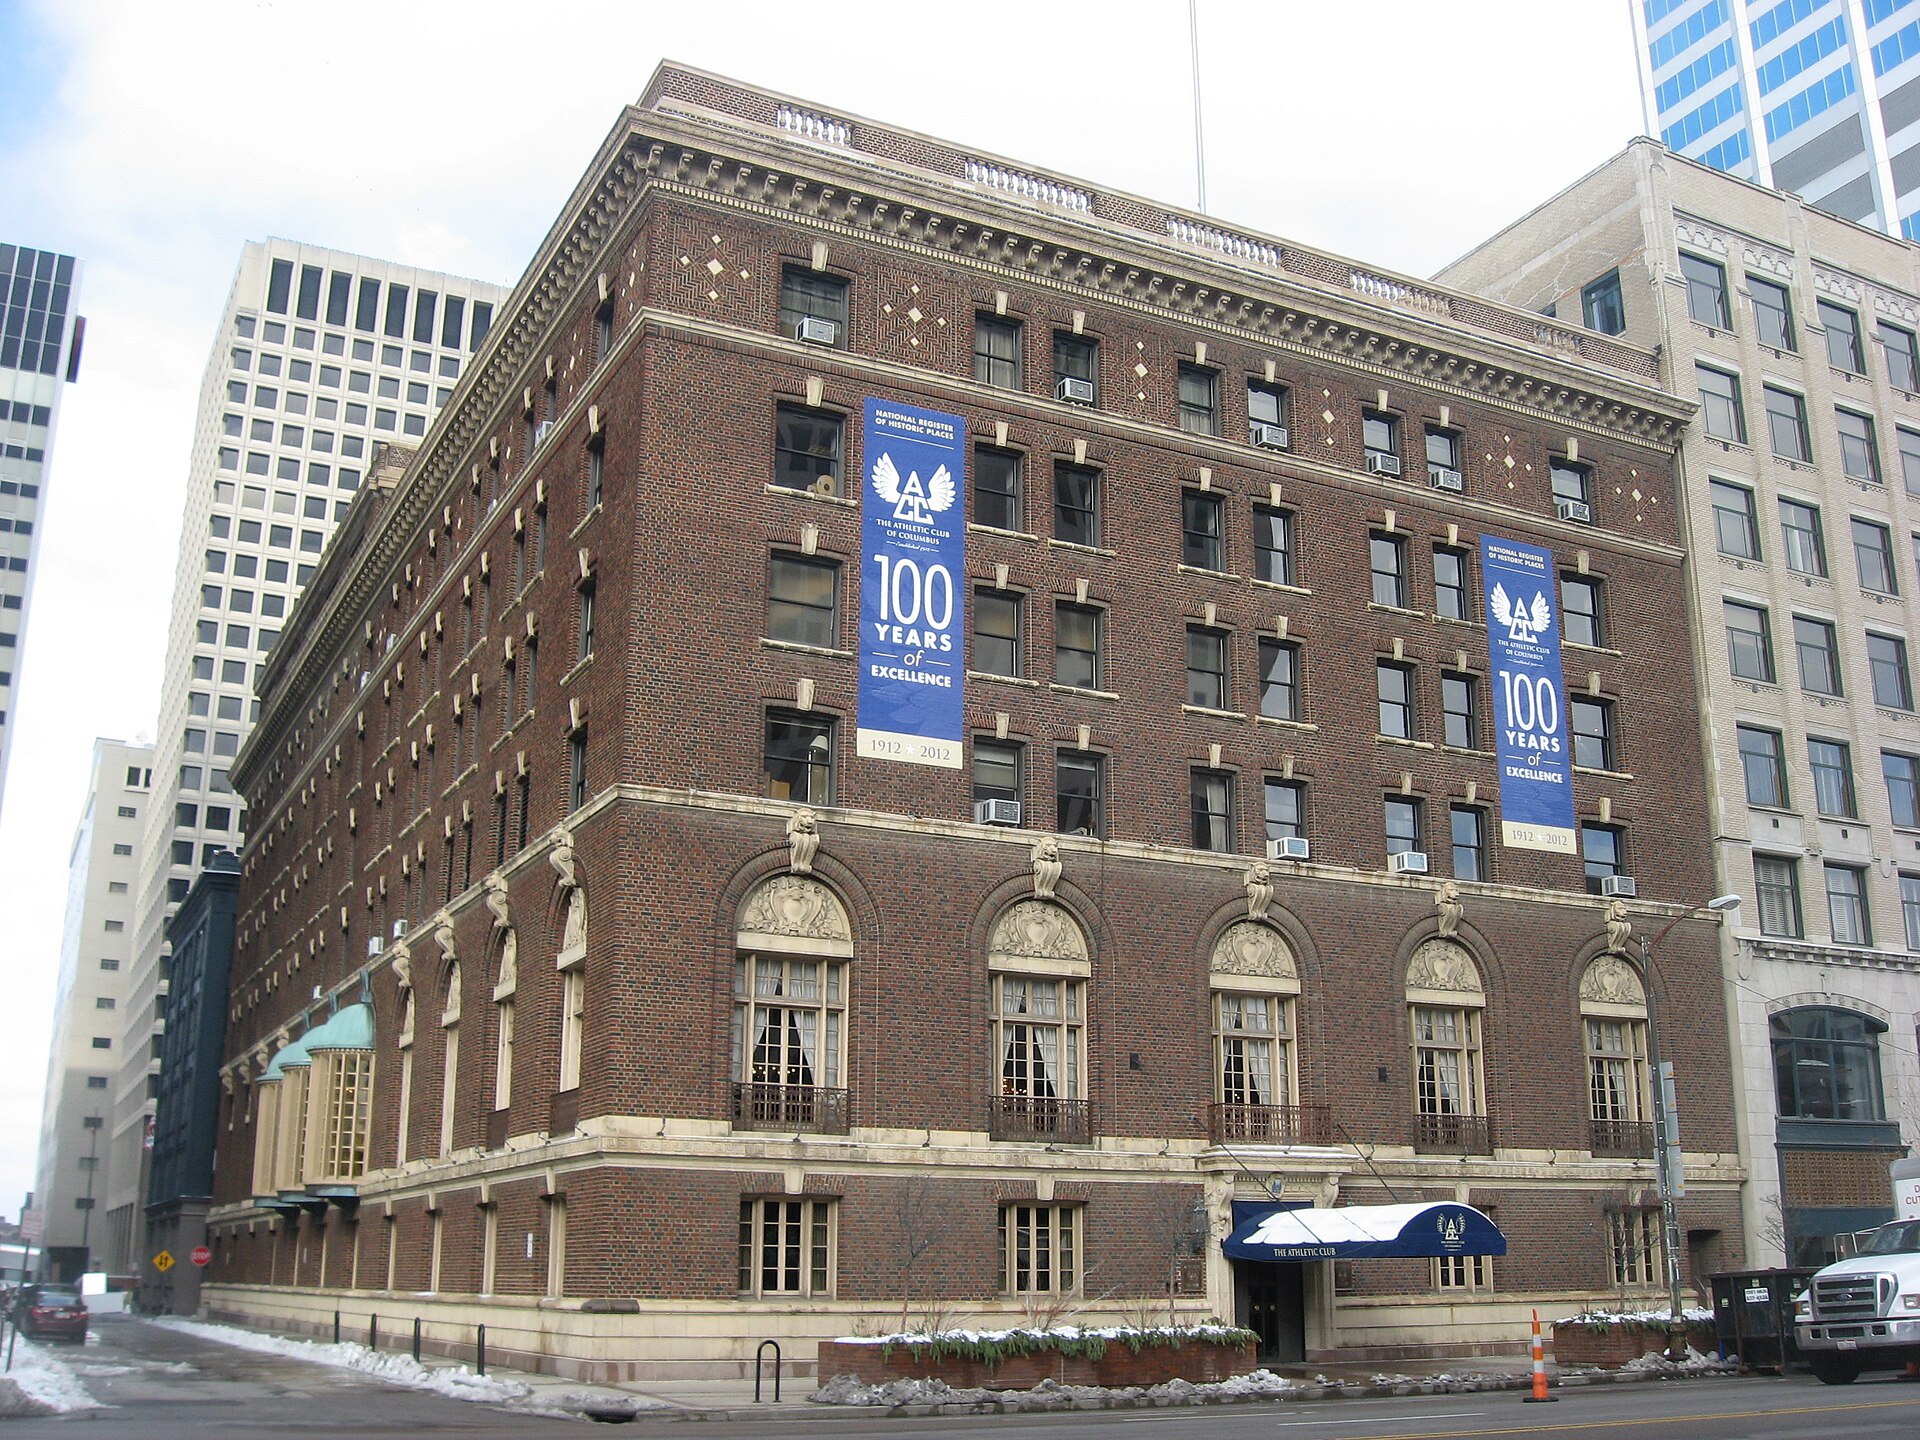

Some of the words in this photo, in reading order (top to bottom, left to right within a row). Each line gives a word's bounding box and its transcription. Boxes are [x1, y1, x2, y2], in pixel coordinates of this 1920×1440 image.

[875, 409, 917, 424] NATIONAL
[918, 418, 954, 432] REGISTER
[875, 417, 887, 426] OF
[888, 420, 925, 434] HISTORIC
[926, 428, 954, 440] PLACES
[876, 518, 892, 527] THE
[893, 522, 930, 535] ATHLETIC
[930, 529, 950, 538] CLUB
[886, 529, 897, 537] OF
[898, 531, 940, 545] COLUMBUS
[1488, 545, 1518, 557] NATIONAL
[1518, 552, 1544, 562] REGISTER
[1497, 554, 1524, 565] HISTORIC
[1524, 560, 1545, 570] PLACES
[873, 554, 954, 631] 100
[874, 622, 952, 652] YEARS
[903, 650, 925, 667] of
[871, 664, 952, 688] EXCELLENCE
[1499, 670, 1558, 735] 100
[871, 739, 902, 755] 1912
[919, 745, 950, 761] 2012
[1505, 729, 1561, 753] YEARS
[1528, 752, 1543, 766] of
[1506, 765, 1564, 784] EXCELLENCE
[1512, 829, 1535, 843] 1912
[1546, 833, 1568, 846] 2012
[1273, 1248, 1287, 1257] THE
[1287, 1247, 1319, 1257] ATHLETIC
[1319, 1247, 1337, 1256] CLUB
